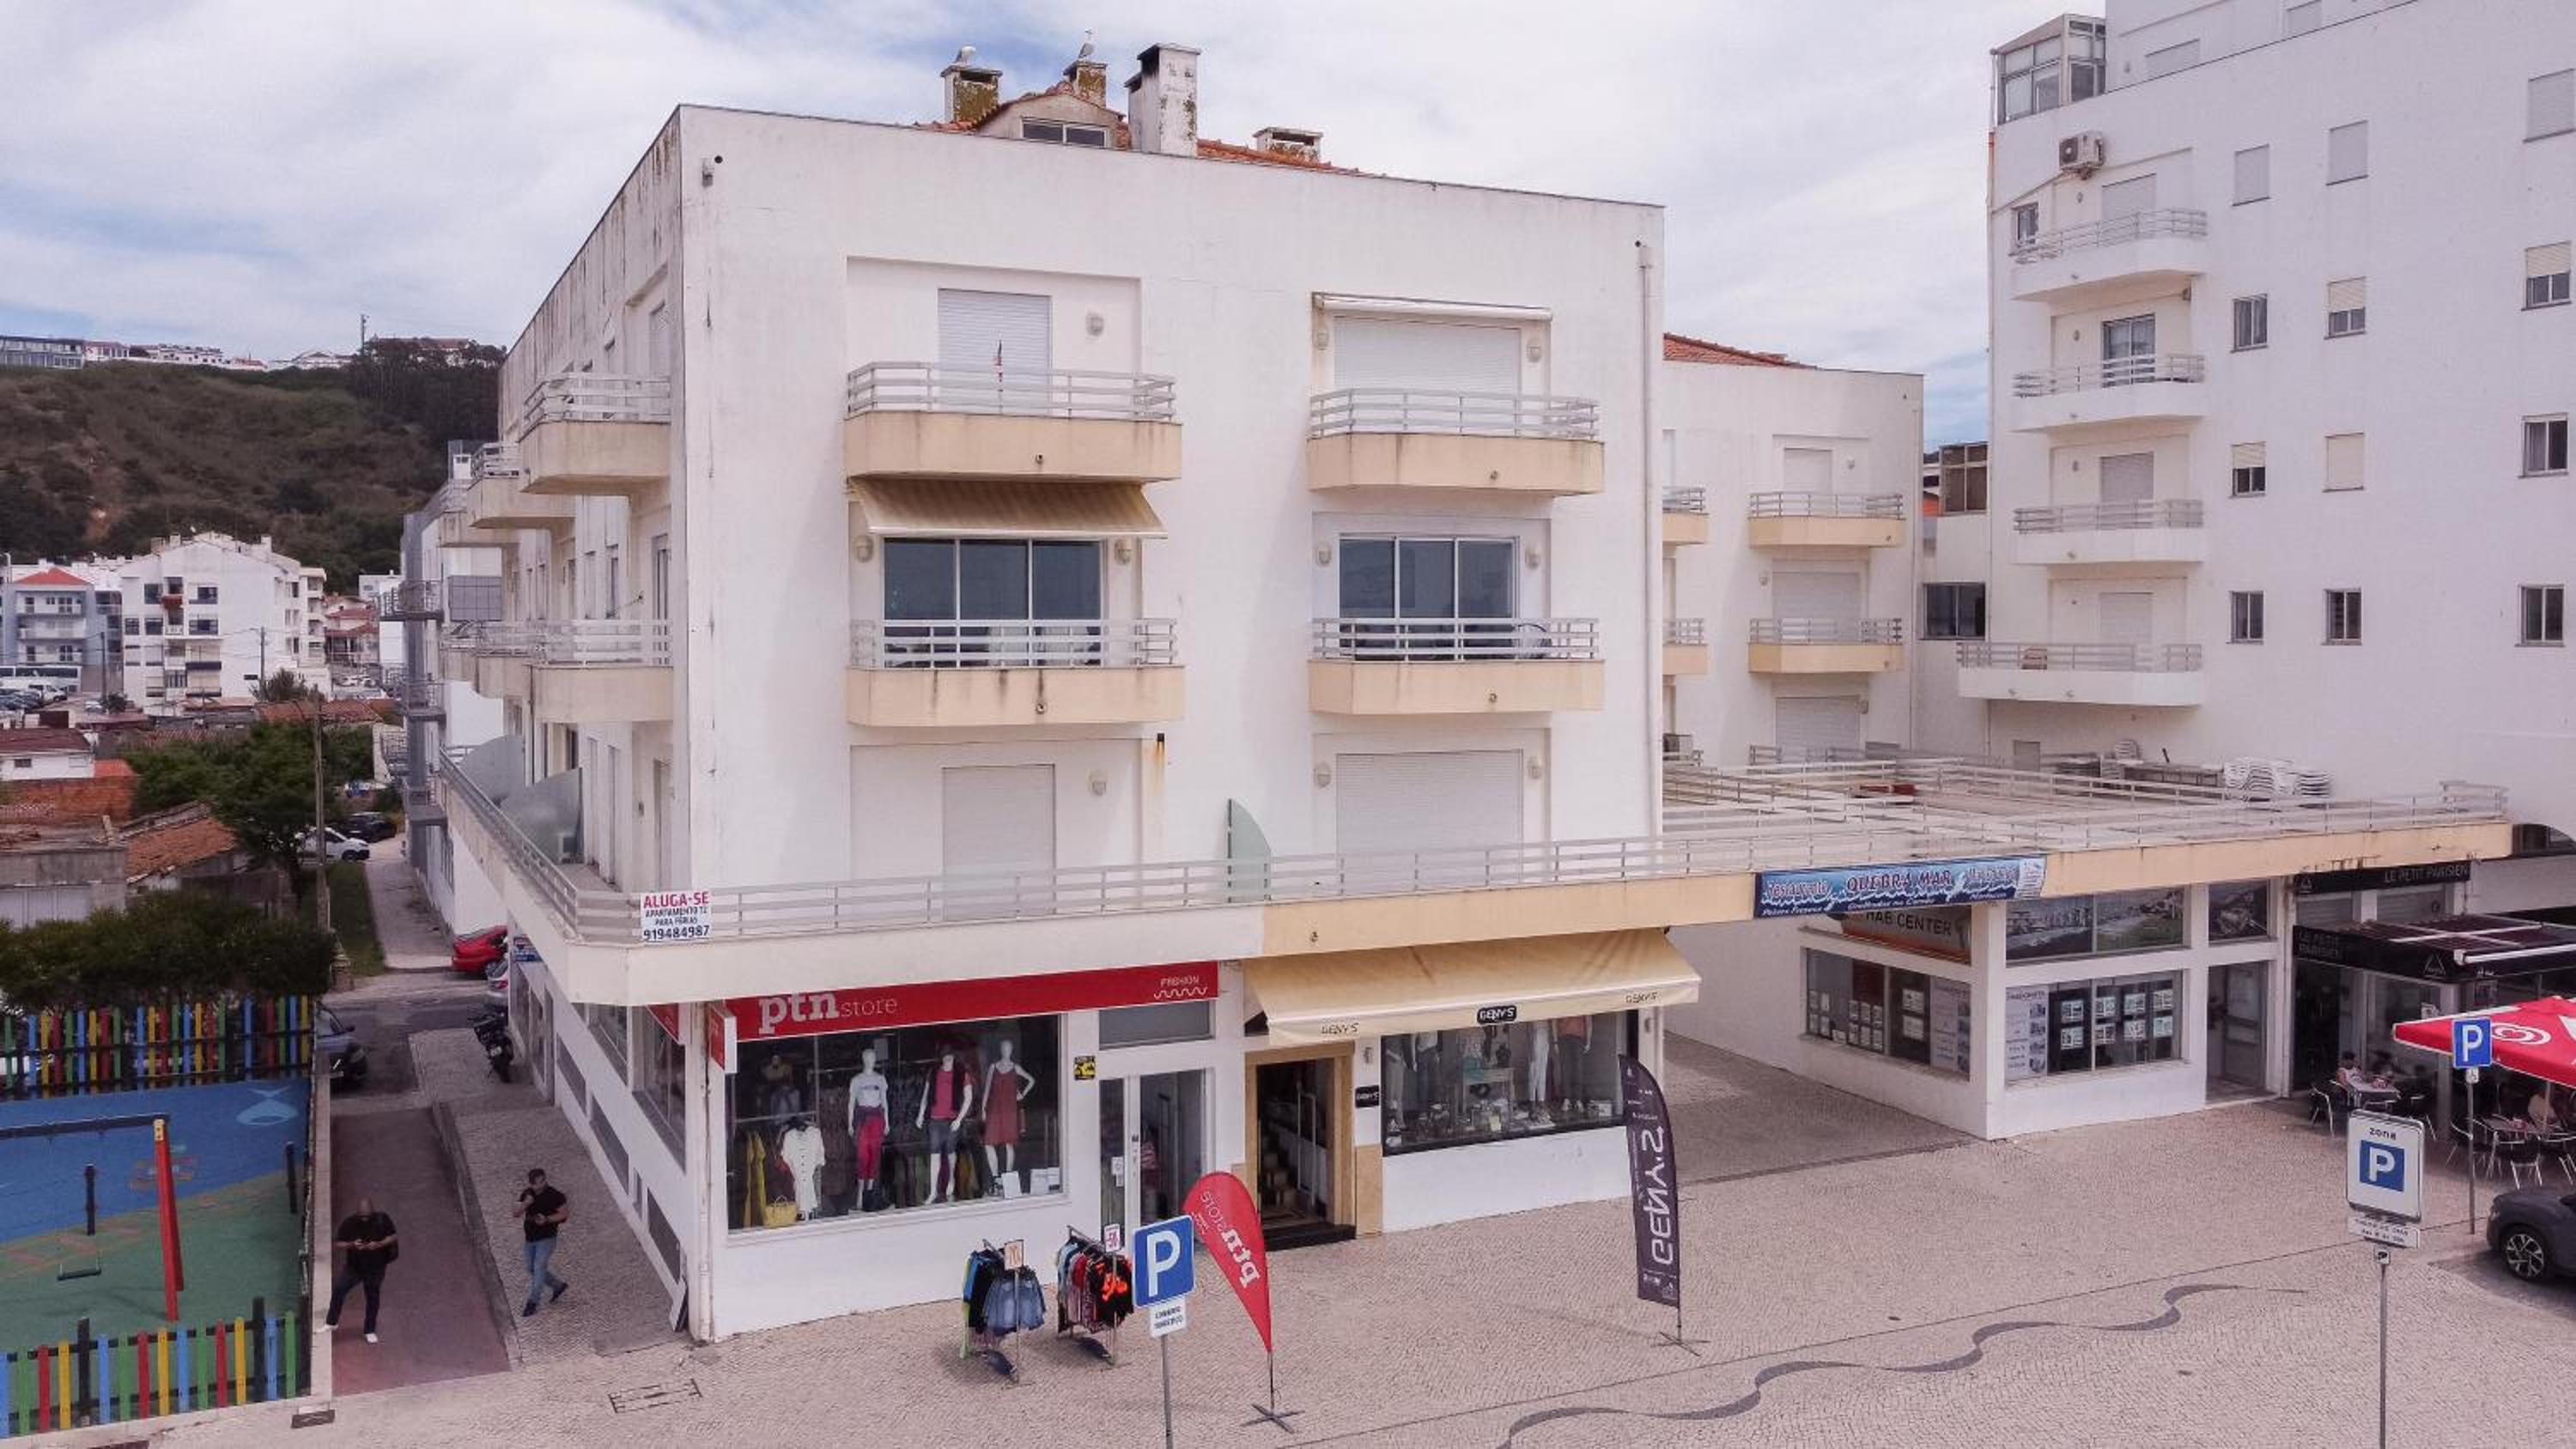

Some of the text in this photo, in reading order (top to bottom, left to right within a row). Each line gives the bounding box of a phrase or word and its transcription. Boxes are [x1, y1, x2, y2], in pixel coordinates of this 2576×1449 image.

[1847, 872, 1912, 892] QUEBRA
[1920, 870, 1953, 887] MAR
[643, 892, 709, 908] ALUGA-SE
[646, 906, 698, 918] APARTAMENTO
[655, 918, 674, 926] PARA
[643, 925, 710, 942] 919484987
[1897, 912, 1952, 937] CENTER
[758, 991, 898, 1035] ptn store
[2462, 1024, 2483, 1062] P
[2368, 1146, 2396, 1182] P
[1146, 1229, 1181, 1298] P
